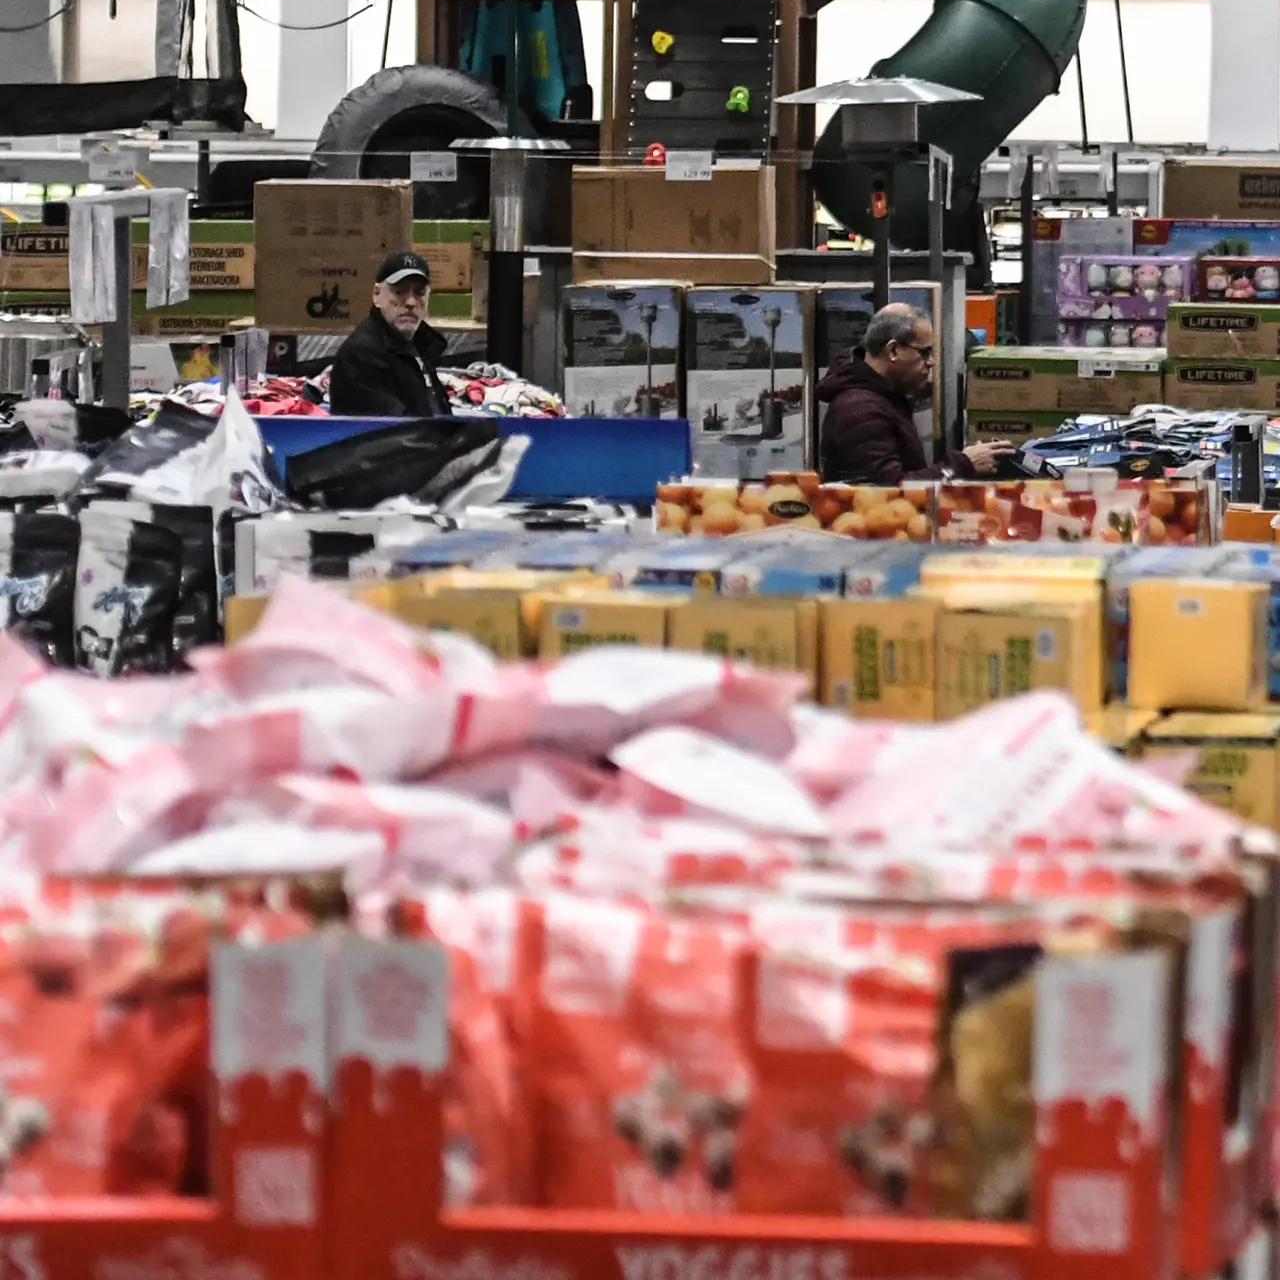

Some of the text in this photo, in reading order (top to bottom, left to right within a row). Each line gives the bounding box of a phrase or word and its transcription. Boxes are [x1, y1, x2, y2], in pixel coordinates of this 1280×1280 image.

[193, 247, 244, 258] STORAGE SHED
[193, 319, 226, 329] STORAGE
[1189, 317, 1249, 328] LIFETIME
[1187, 371, 1246, 381] LIFETIME
